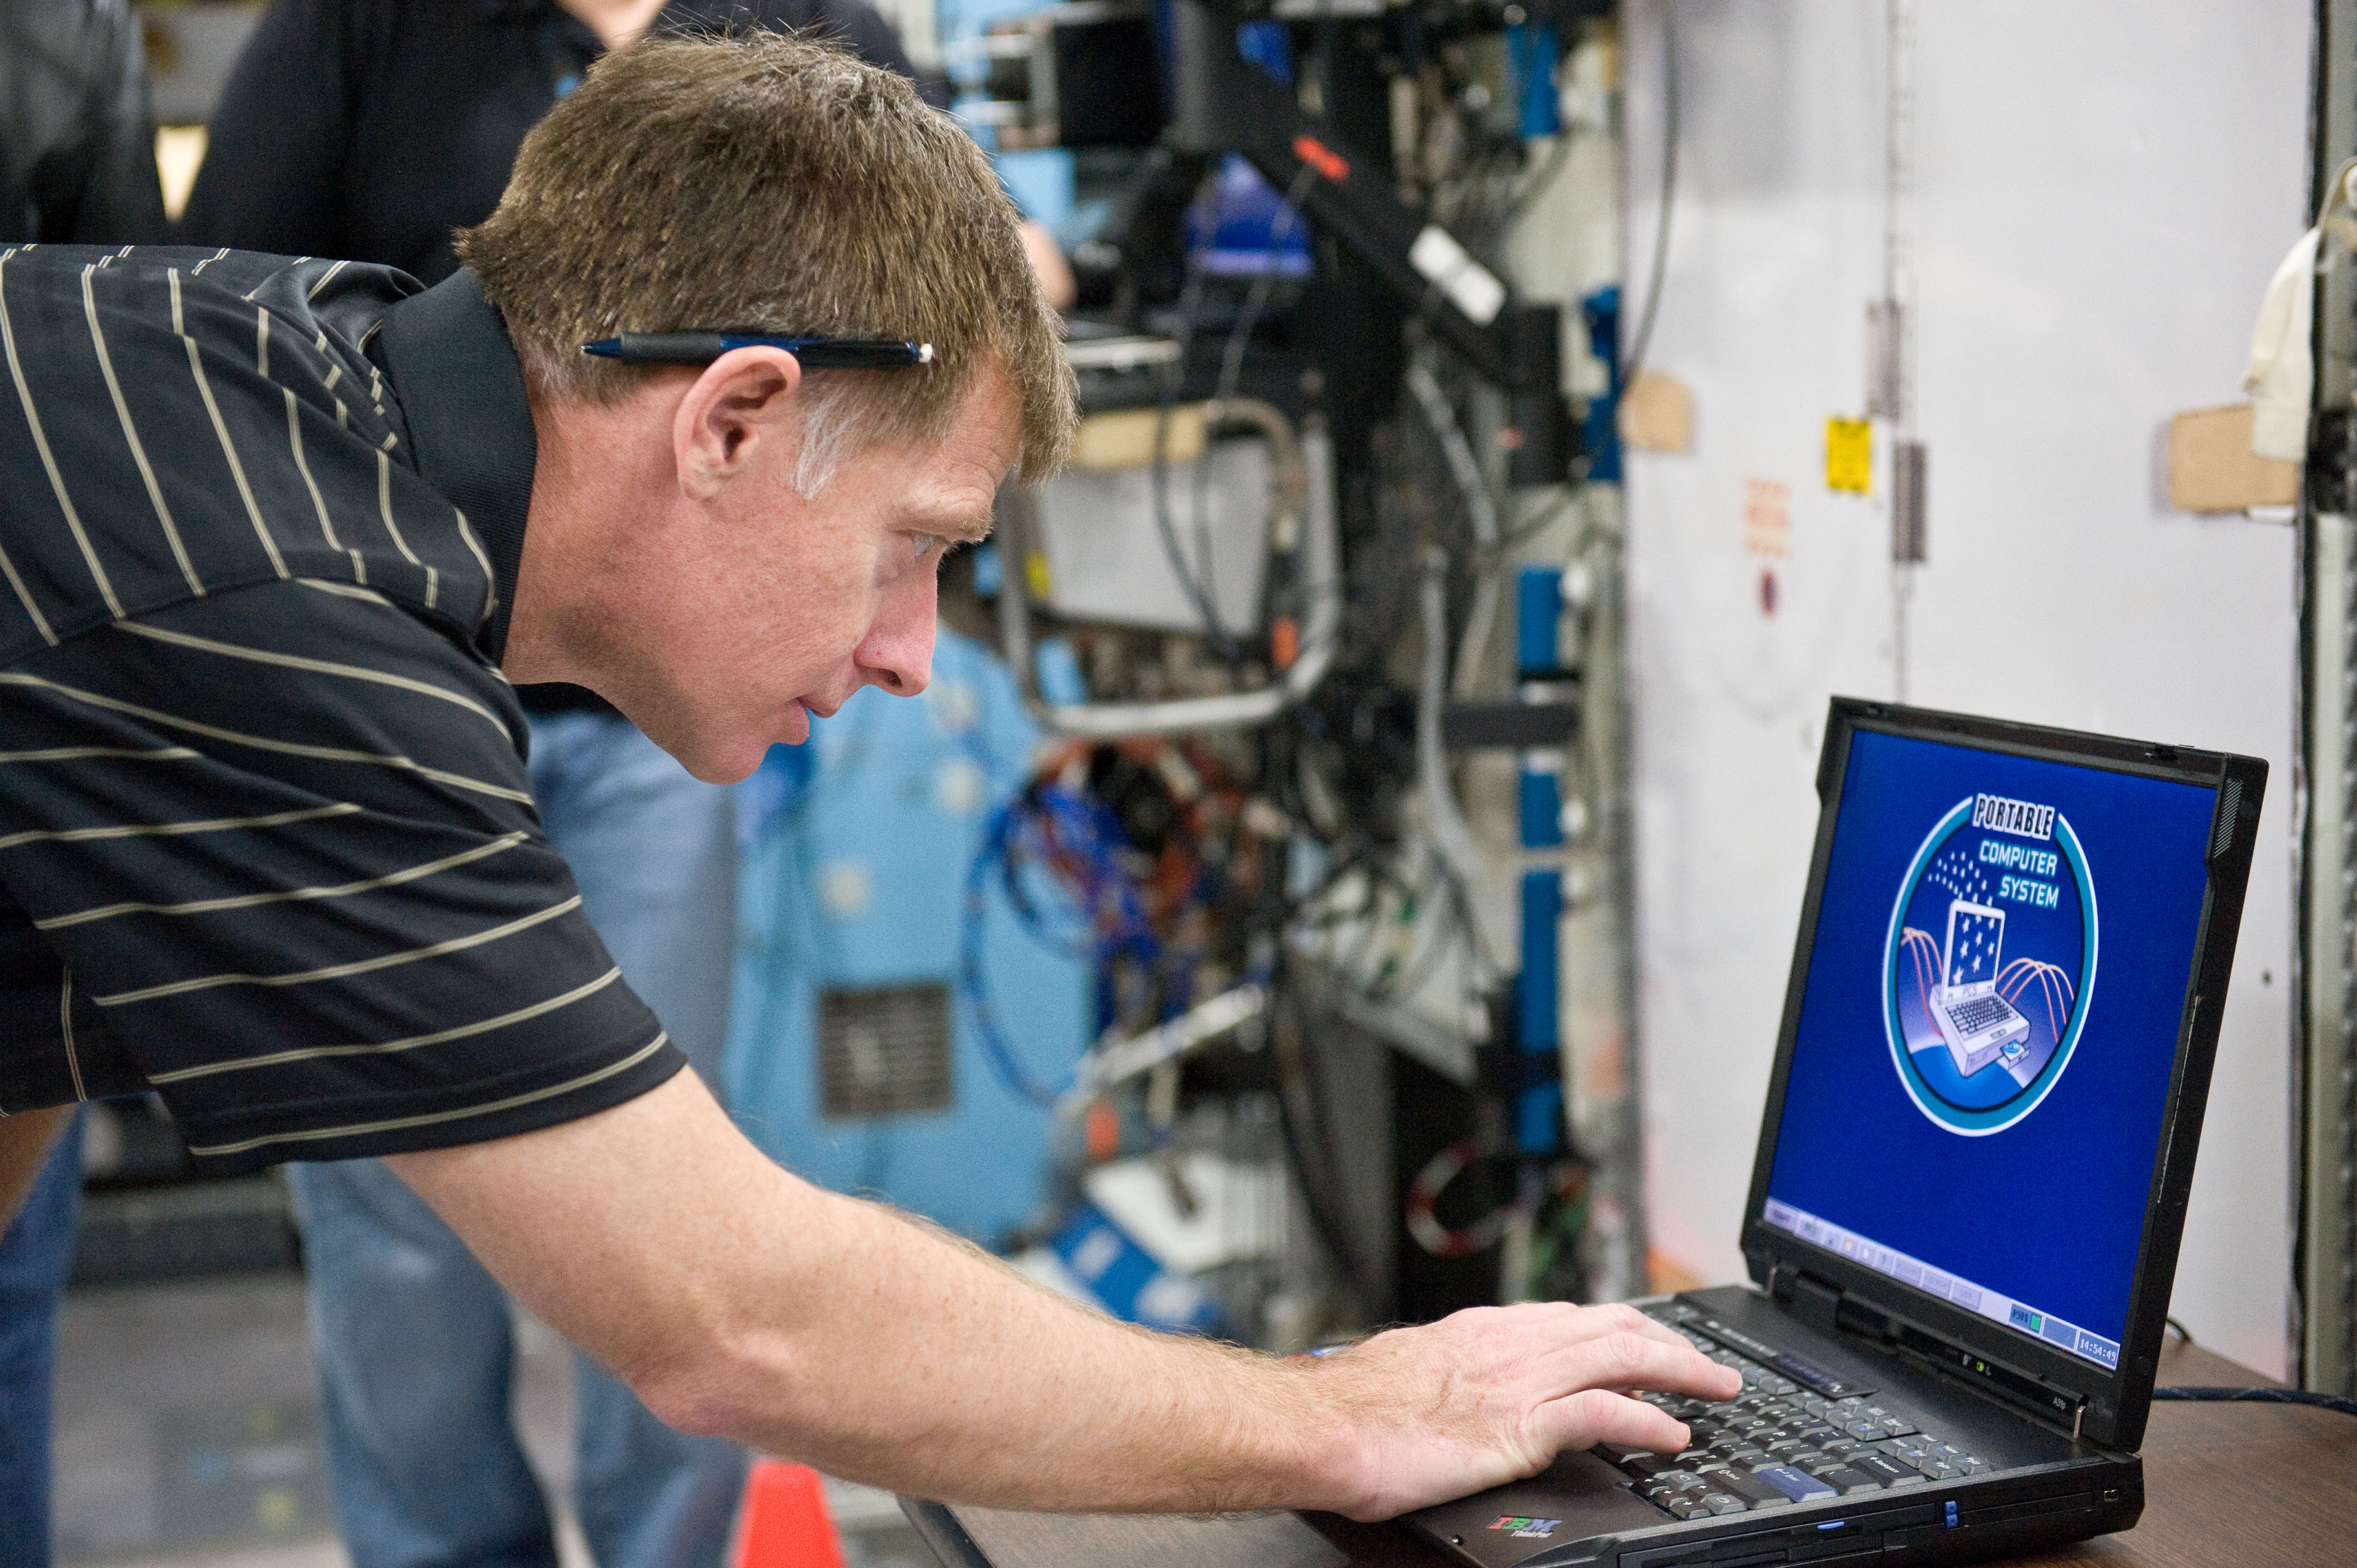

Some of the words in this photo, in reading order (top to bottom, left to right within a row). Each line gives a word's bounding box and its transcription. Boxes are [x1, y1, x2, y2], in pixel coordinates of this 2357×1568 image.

[1973, 793, 2055, 840] PORTABLE
[1979, 840, 2058, 876] COMPUTER
[1999, 876, 2060, 909] SYSTEM
[2080, 1338, 2117, 1362] 14:54:49
[1488, 1517, 1563, 1532] IBM
